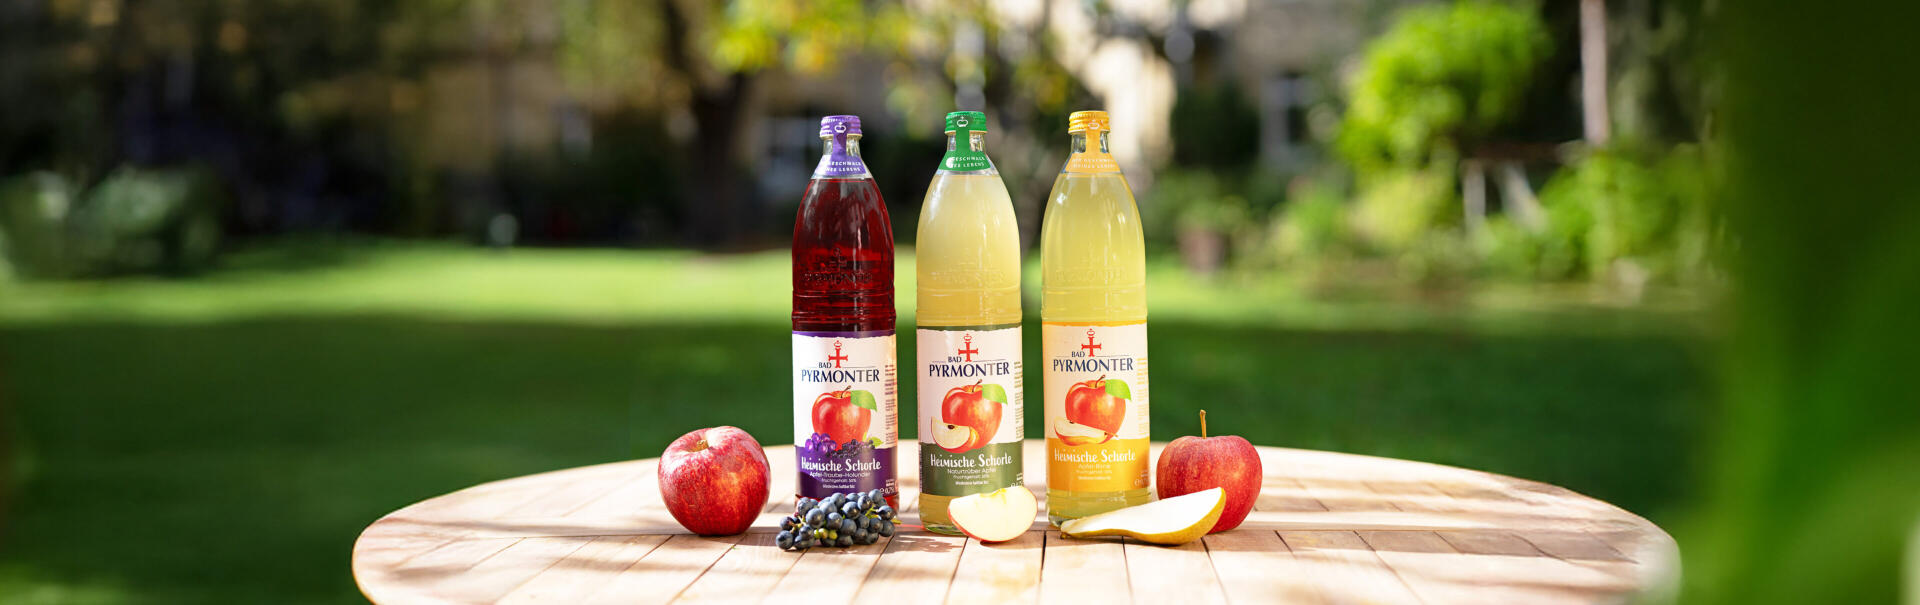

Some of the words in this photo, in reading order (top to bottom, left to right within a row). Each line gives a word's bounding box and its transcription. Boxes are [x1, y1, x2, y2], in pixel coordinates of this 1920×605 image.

[818, 361, 832, 369] BAD
[929, 361, 1010, 378] PYRMONTER
[1053, 357, 1134, 373] PYRMONTER
[801, 369, 880, 383] PYRMONTER
[930, 453, 976, 468] Heimische
[978, 452, 1013, 467] Schorle
[1054, 447, 1098, 463] Heimische
[1101, 448, 1136, 463] Schorle
[801, 456, 842, 472] Heimische
[845, 457, 882, 472] Schorle
